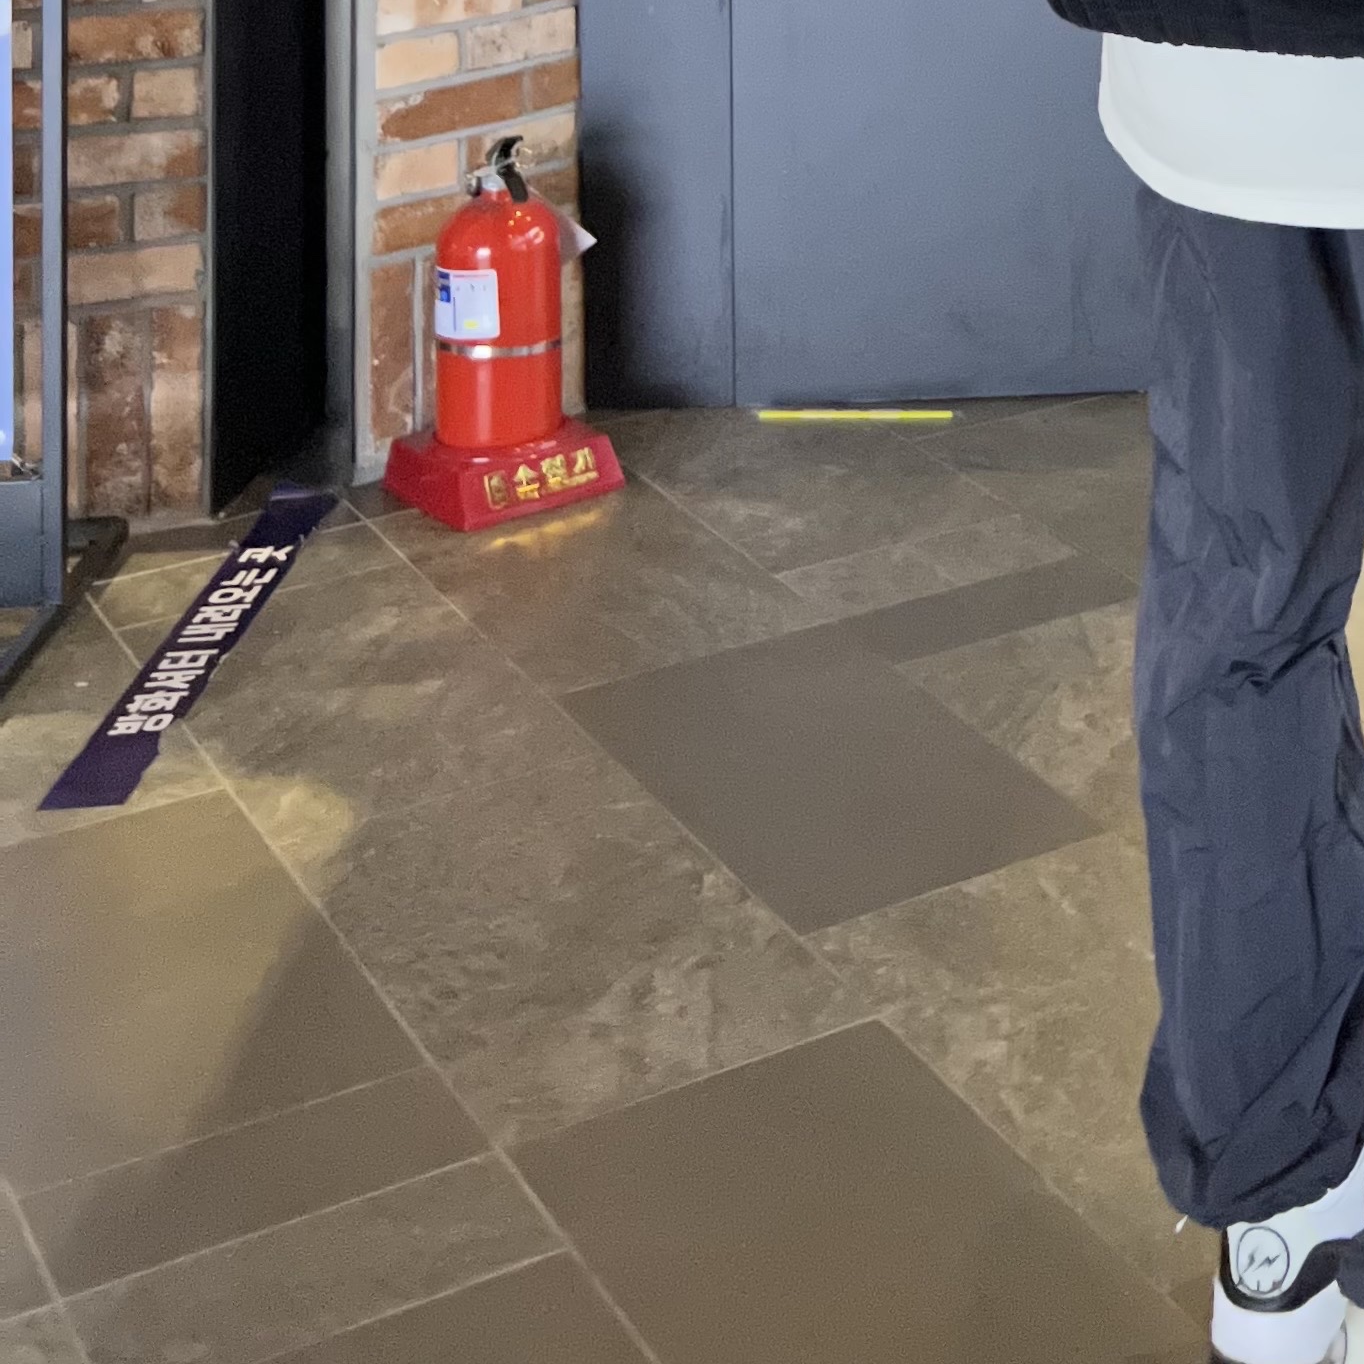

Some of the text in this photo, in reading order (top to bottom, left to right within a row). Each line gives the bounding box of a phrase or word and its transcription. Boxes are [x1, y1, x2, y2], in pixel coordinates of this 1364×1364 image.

[107, 544, 295, 737] 방화셔터 내려오는 곳
